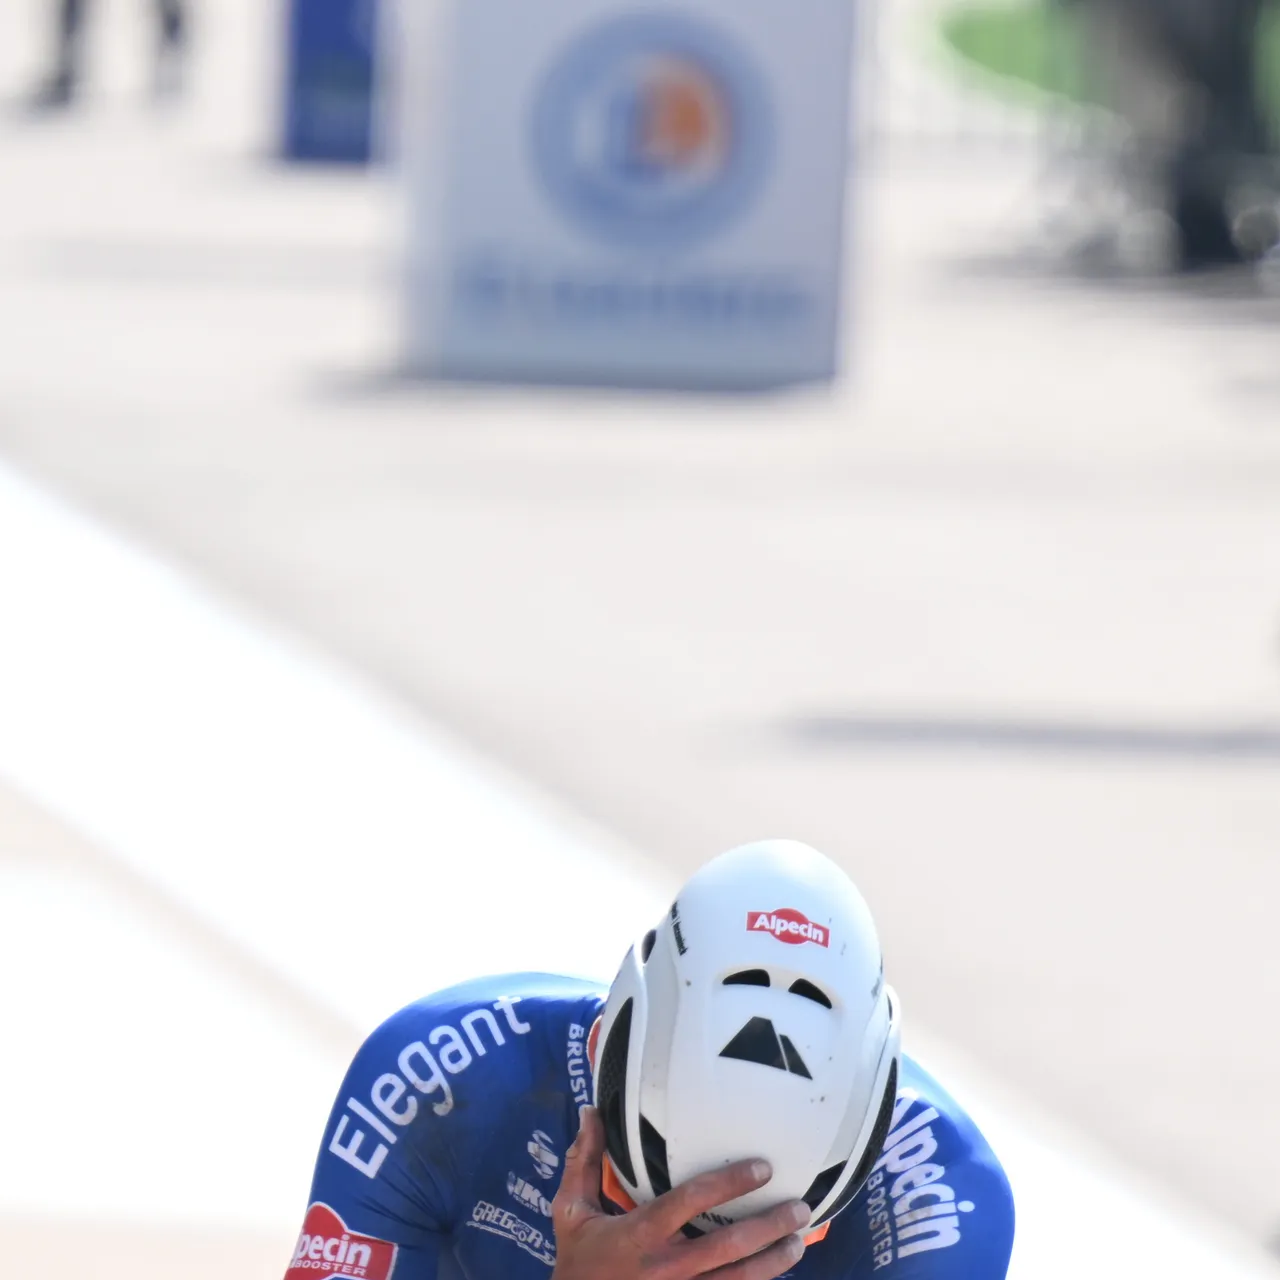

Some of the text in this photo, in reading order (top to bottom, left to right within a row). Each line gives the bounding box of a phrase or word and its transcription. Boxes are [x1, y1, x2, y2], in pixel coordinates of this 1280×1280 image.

[753, 913, 825, 943] Alpecin
[328, 996, 532, 1179] Elegant
[866, 1170, 894, 1272] BOOSTER
